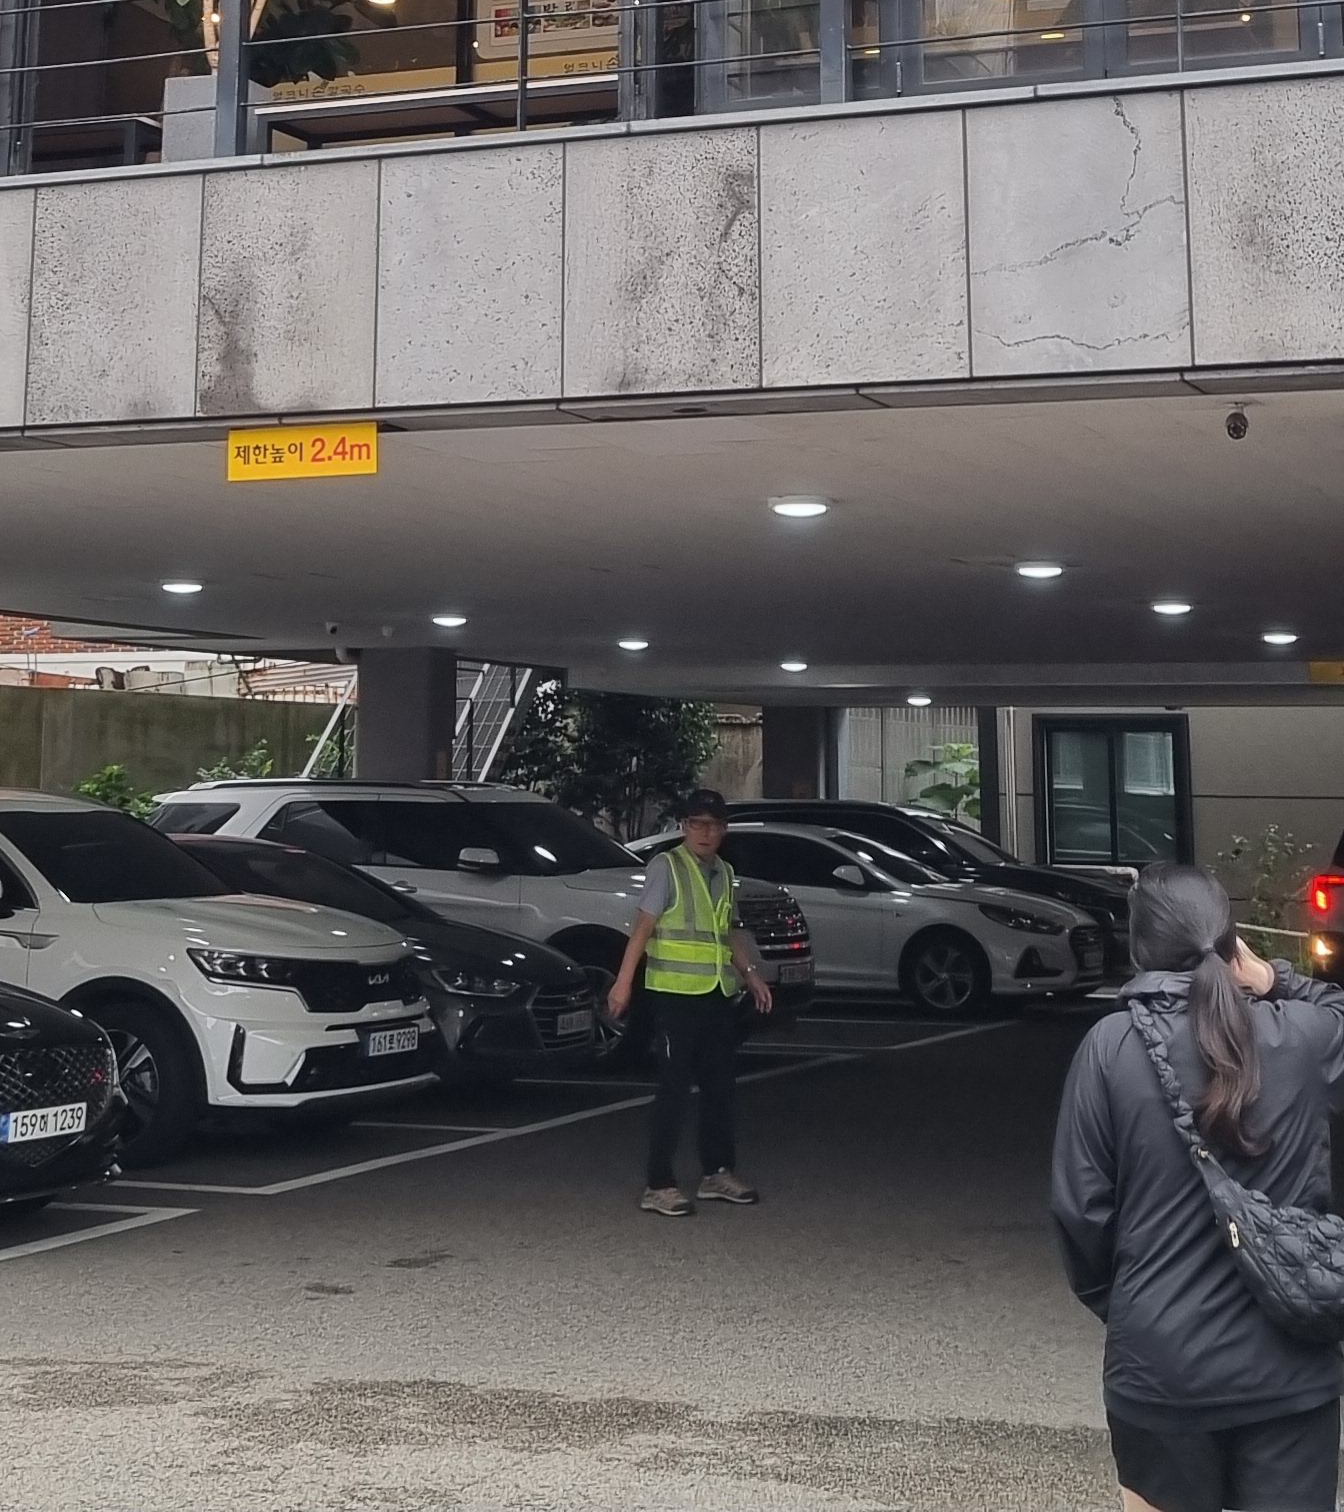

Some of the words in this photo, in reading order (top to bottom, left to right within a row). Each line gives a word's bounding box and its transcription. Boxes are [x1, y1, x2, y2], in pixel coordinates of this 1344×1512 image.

[234, 441, 304, 465] 제한높이
[310, 436, 371, 463] 2.4m
[52, 1106, 84, 1132] 1239
